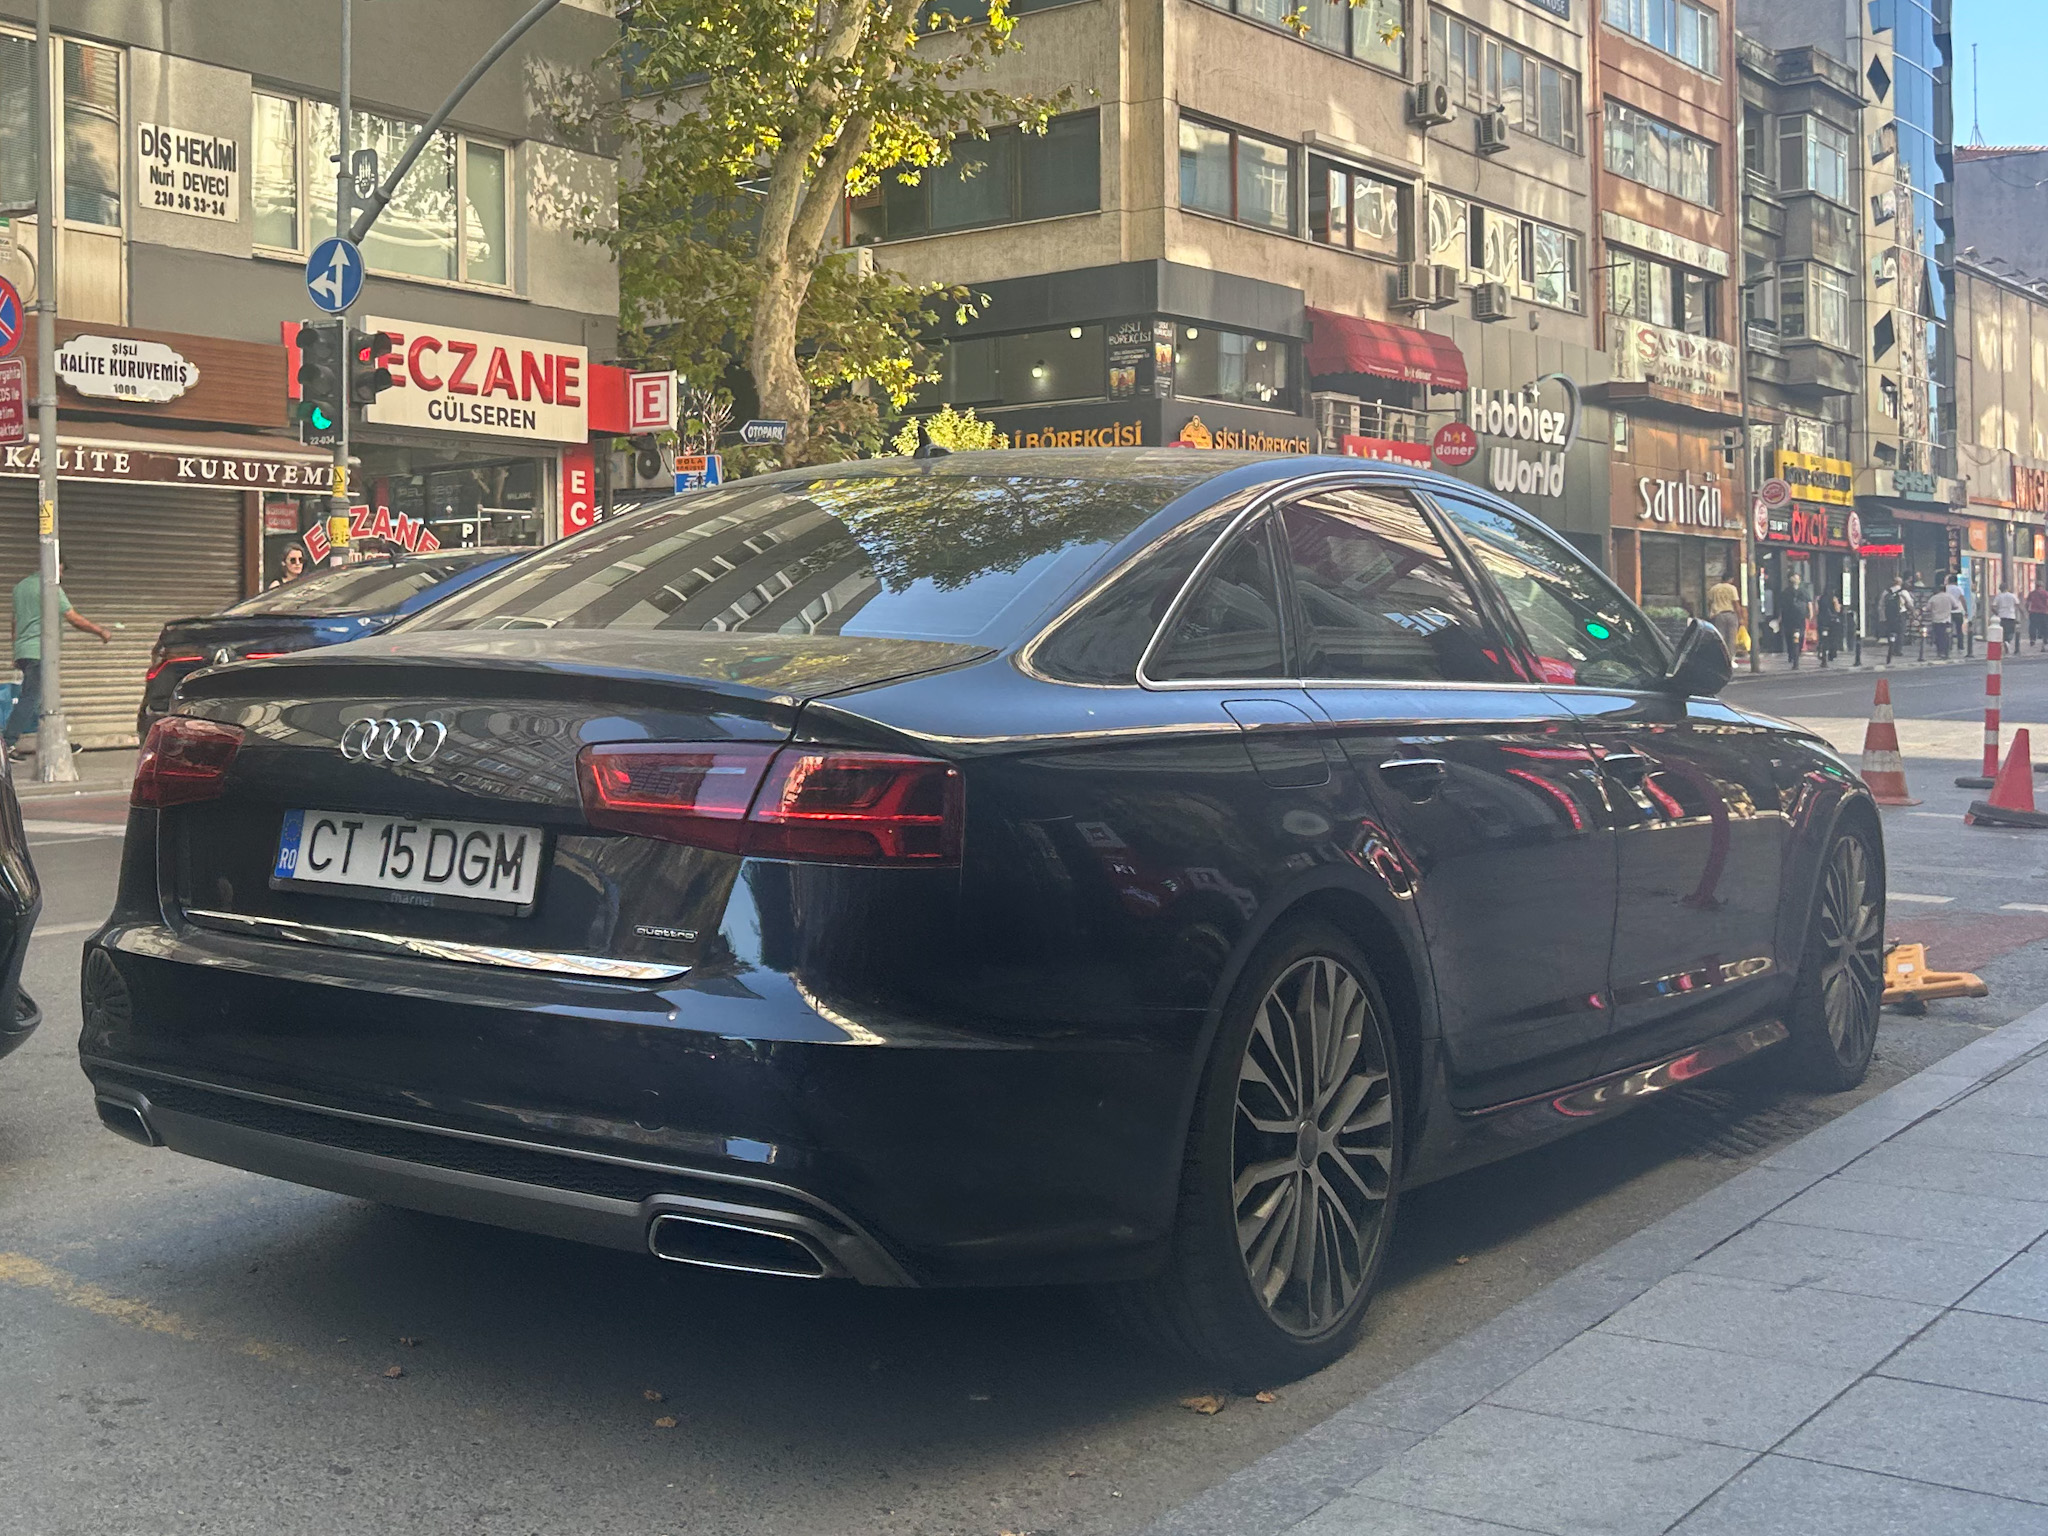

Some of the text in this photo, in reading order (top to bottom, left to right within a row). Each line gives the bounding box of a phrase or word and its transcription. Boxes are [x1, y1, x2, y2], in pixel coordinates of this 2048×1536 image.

[141, 125, 236, 172] DİŞ HEKİMİ
[150, 165, 229, 197] Nuri DEVECİ
[154, 190, 225, 216] 230 36 33-34
[112, 343, 138, 356] ŞİŞLİ
[60, 351, 187, 386] KALİTE KURUYEMİŞ
[375, 330, 581, 408] ECZANE
[428, 395, 536, 430] GÜLSEREN
[642, 384, 661, 419] E
[1471, 386, 1566, 445] Hobbiez
[747, 424, 783, 440] OTOPARK
[1490, 447, 1566, 498] World
[302, 504, 441, 565] EZANE
[279, 848, 298, 869] RO
[308, 819, 527, 892] CT 15 DGM
[636, 927, 695, 939] quattro
